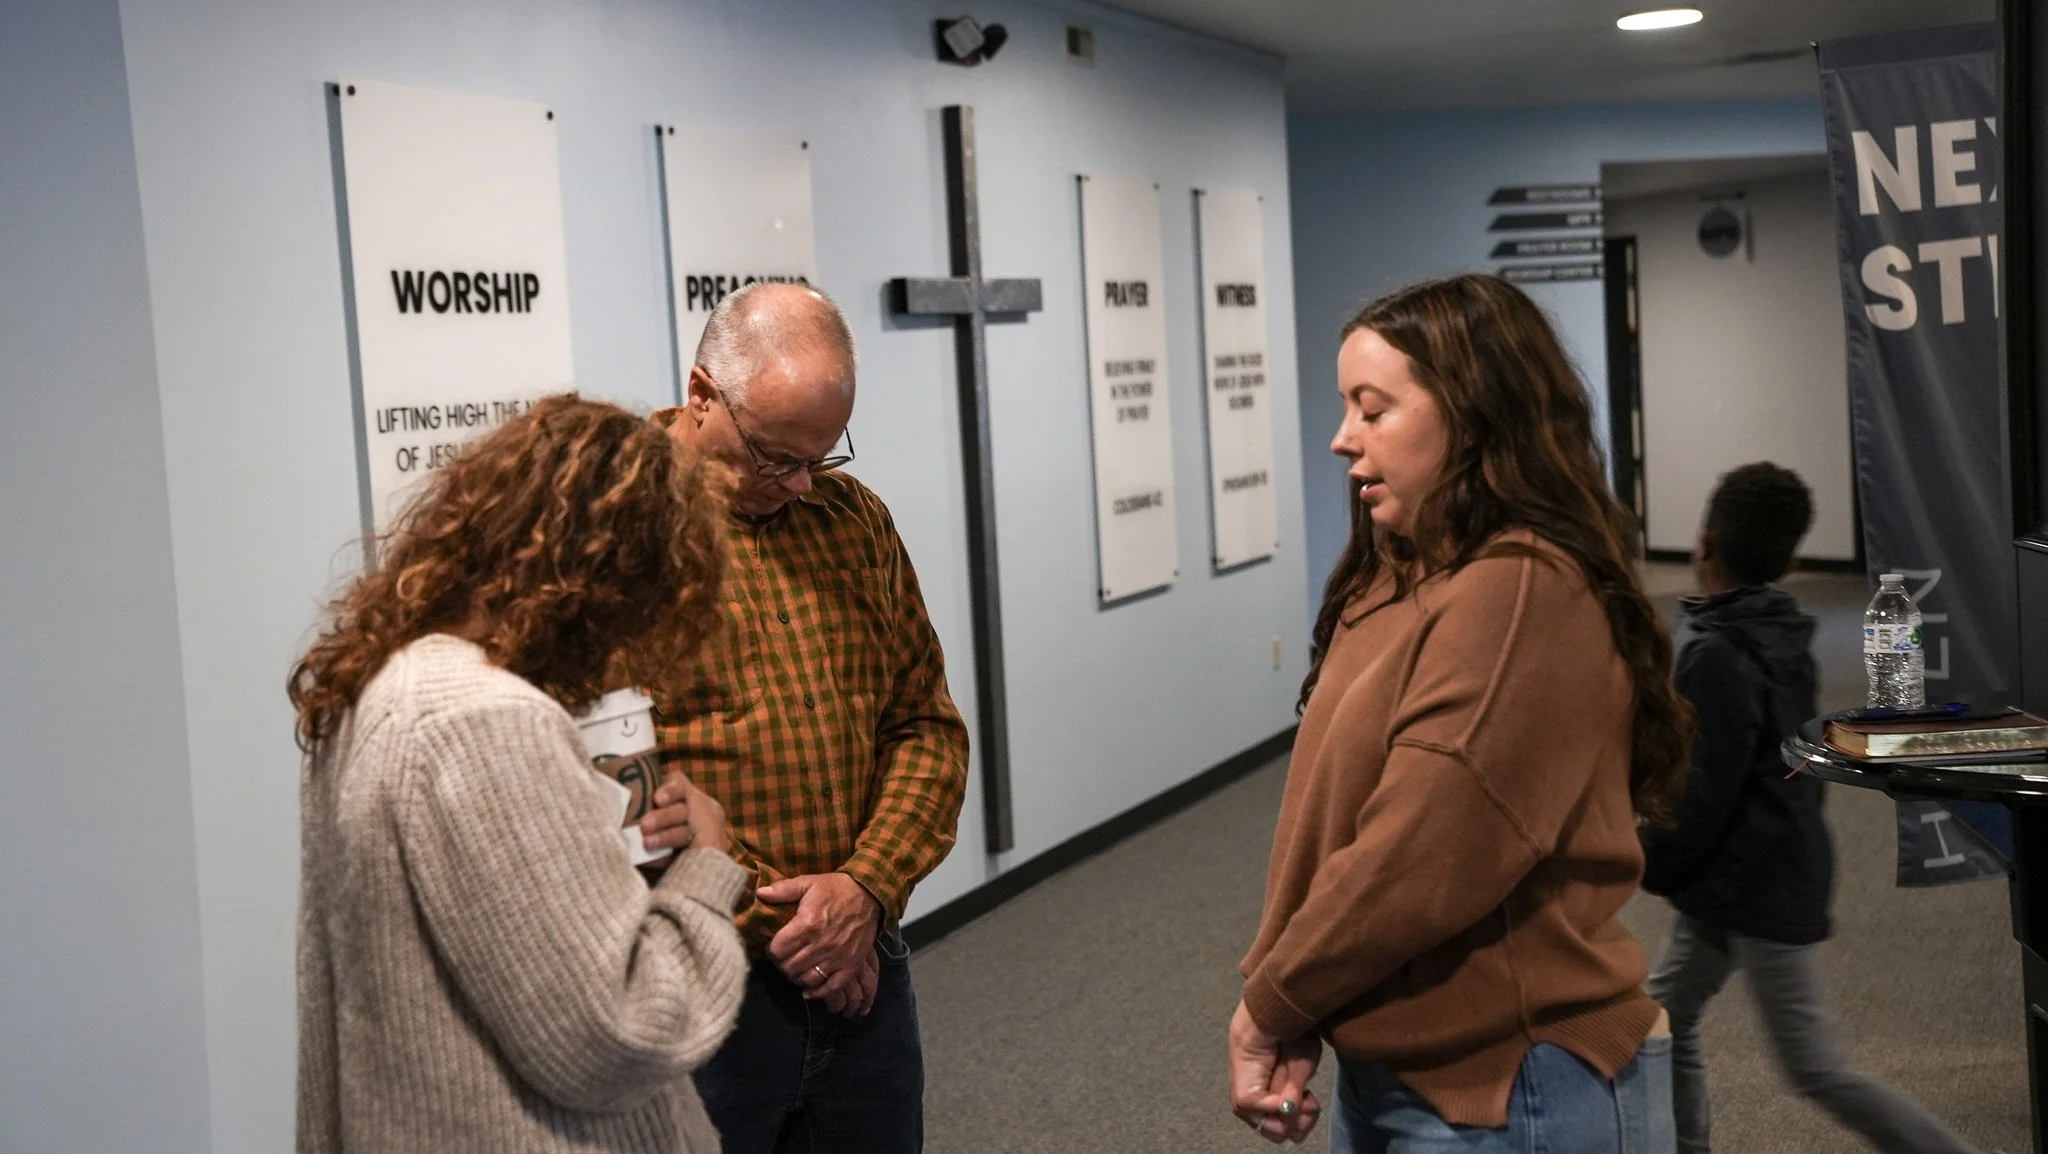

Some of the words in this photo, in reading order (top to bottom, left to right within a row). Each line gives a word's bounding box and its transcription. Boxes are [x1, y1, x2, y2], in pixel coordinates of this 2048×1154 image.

[1852, 116, 1998, 216] NE
[390, 270, 540, 314] WORSHIP
[1104, 281, 1148, 307] PRAYER
[1215, 284, 1256, 307] WITNESS
[1861, 234, 1999, 331] ST
[377, 406, 441, 433] LIFTING
[446, 403, 489, 428] HIGH
[396, 447, 420, 472] OF
